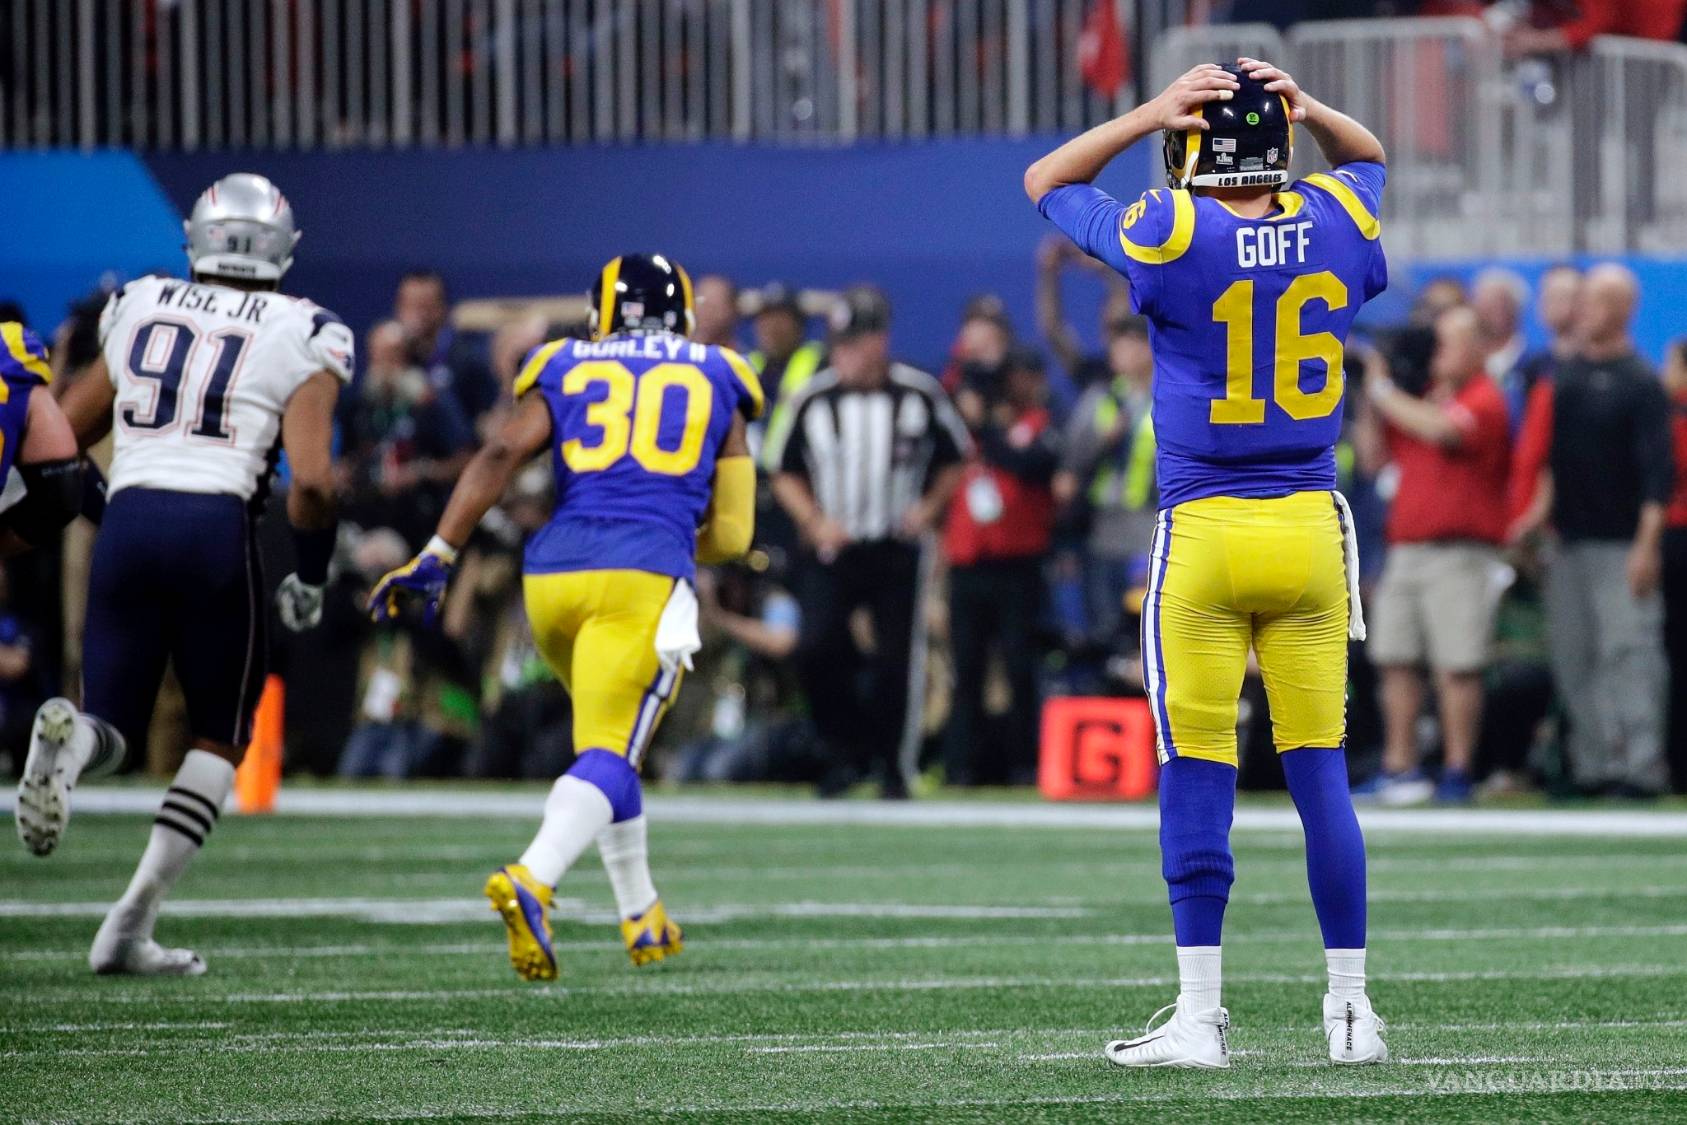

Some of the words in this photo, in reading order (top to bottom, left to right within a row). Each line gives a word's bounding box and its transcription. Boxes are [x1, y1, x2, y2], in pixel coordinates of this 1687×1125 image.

[1218, 176, 1238, 186] LOS
[1241, 173, 1282, 185] ANGELES
[226, 235, 252, 254] 91
[1236, 220, 1313, 268] GOFF
[156, 283, 218, 313] WISE
[226, 292, 268, 323] JR
[1209, 270, 1348, 424] 16
[117, 313, 254, 447] 91
[561, 360, 714, 477] 30
[1071, 719, 1124, 796] G
